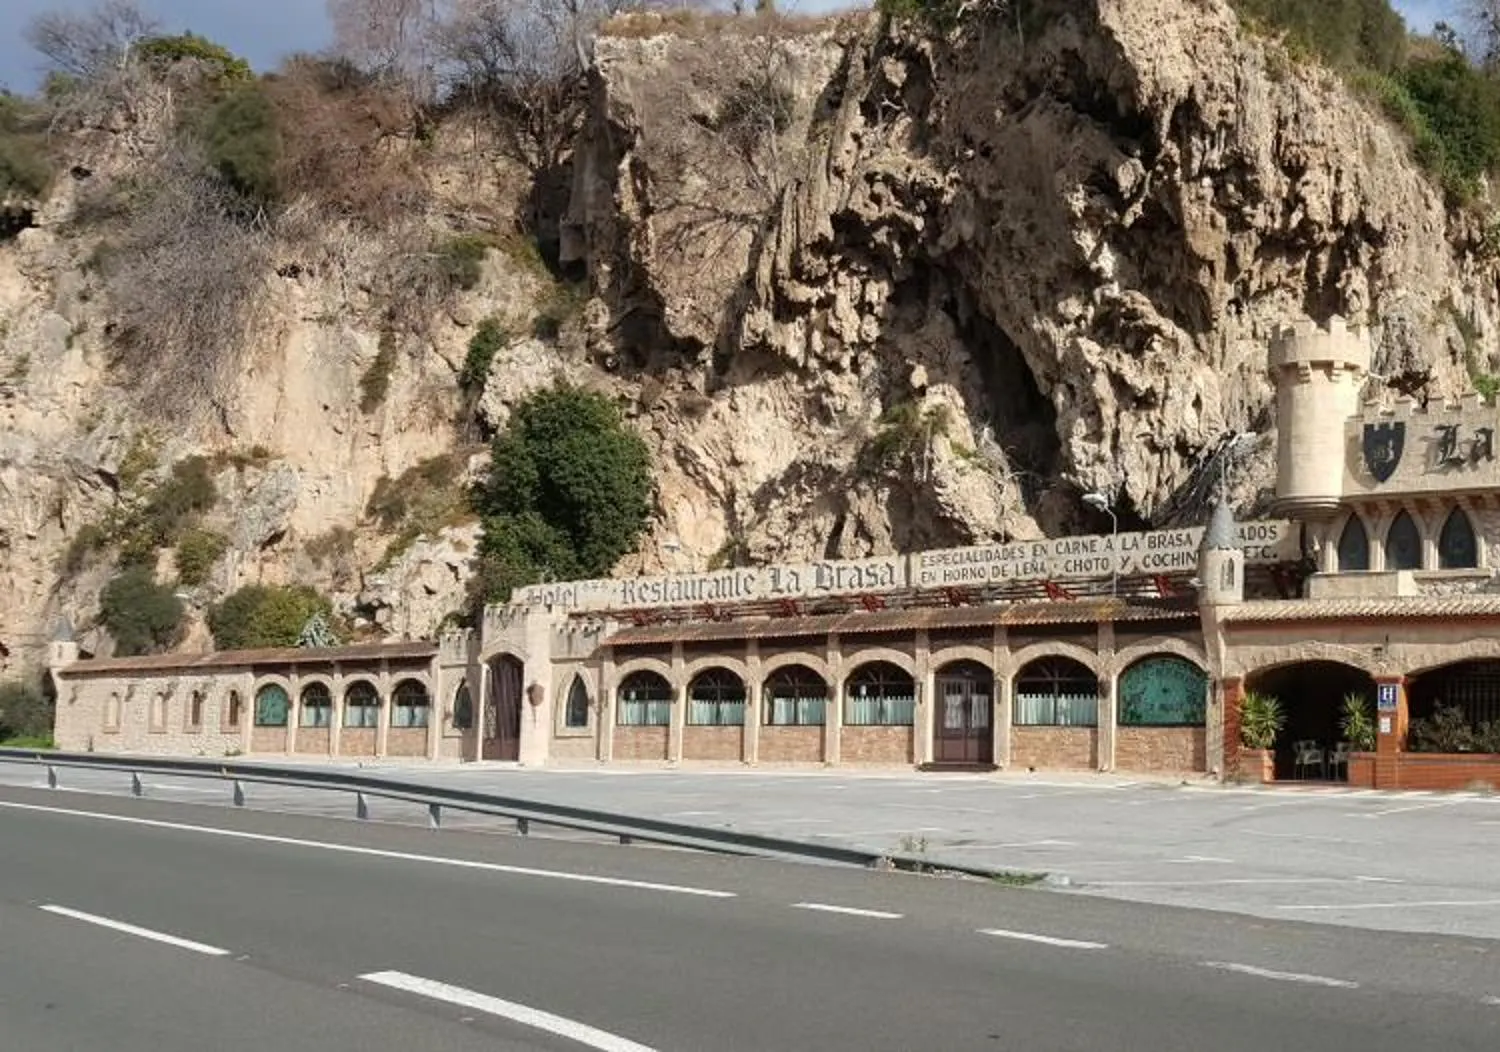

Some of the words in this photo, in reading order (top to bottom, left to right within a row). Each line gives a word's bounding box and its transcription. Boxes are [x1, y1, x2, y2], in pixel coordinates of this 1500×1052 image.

[1434, 423, 1495, 467] La
[920, 544, 1026, 567] ESPECIALIDADES
[1032, 543, 1048, 557] EN
[1055, 539, 1097, 555] CARNE
[1103, 538, 1115, 552] A
[1121, 536, 1140, 551] LA
[1147, 533, 1193, 549] BRASA
[921, 570, 936, 583] EN
[943, 567, 986, 582] HORNO
[992, 565, 1009, 579] DE
[1014, 560, 1047, 576] LEÑA
[1064, 557, 1110, 573] CHOTO
[1120, 556, 1132, 571] Y
[526, 583, 579, 609] Hotel
[620, 568, 756, 605] Restaurante
[769, 567, 800, 594] La
[811, 561, 896, 590] Brasa
